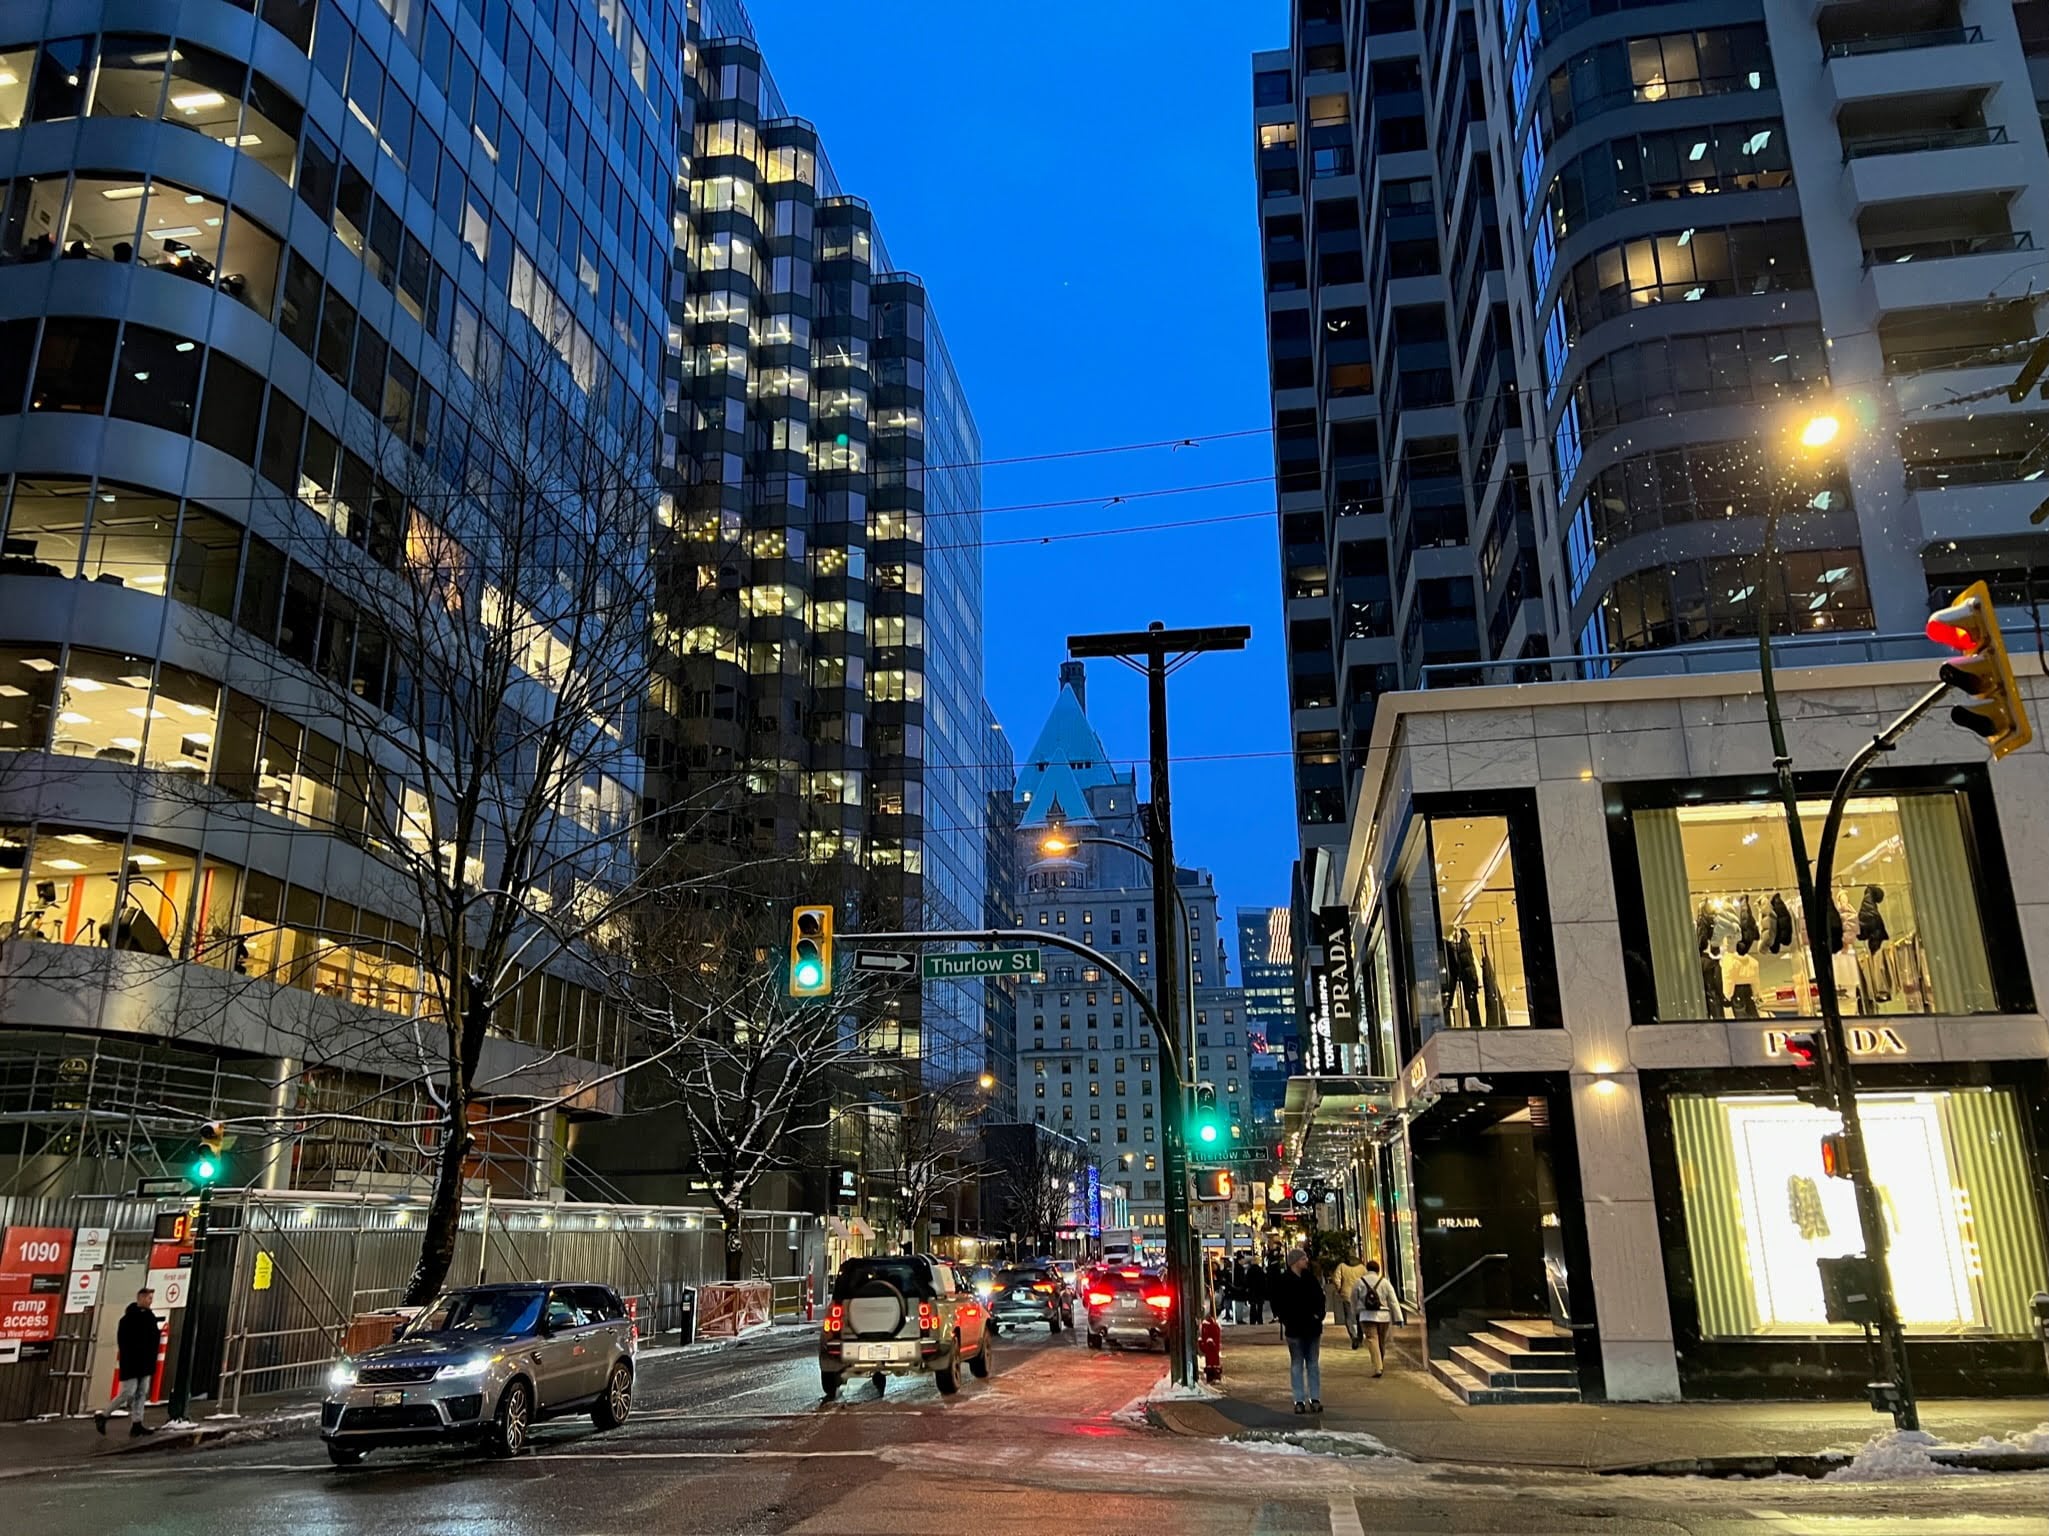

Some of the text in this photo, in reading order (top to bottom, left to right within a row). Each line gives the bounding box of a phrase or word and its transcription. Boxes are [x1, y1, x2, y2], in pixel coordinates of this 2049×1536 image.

[930, 953, 1032, 974] Thurlow St
[1328, 927, 1351, 1019] PRADA
[1763, 1027, 1907, 1057] PDA
[1324, 1036, 1335, 1070] TORY
[1218, 1172, 1230, 1196] 6
[173, 1216, 184, 1238] 6
[1438, 1217, 1482, 1228] PRADA
[19, 1241, 60, 1262] 1090
[12, 1299, 47, 1314] ramp
[3, 1315, 49, 1328] access
